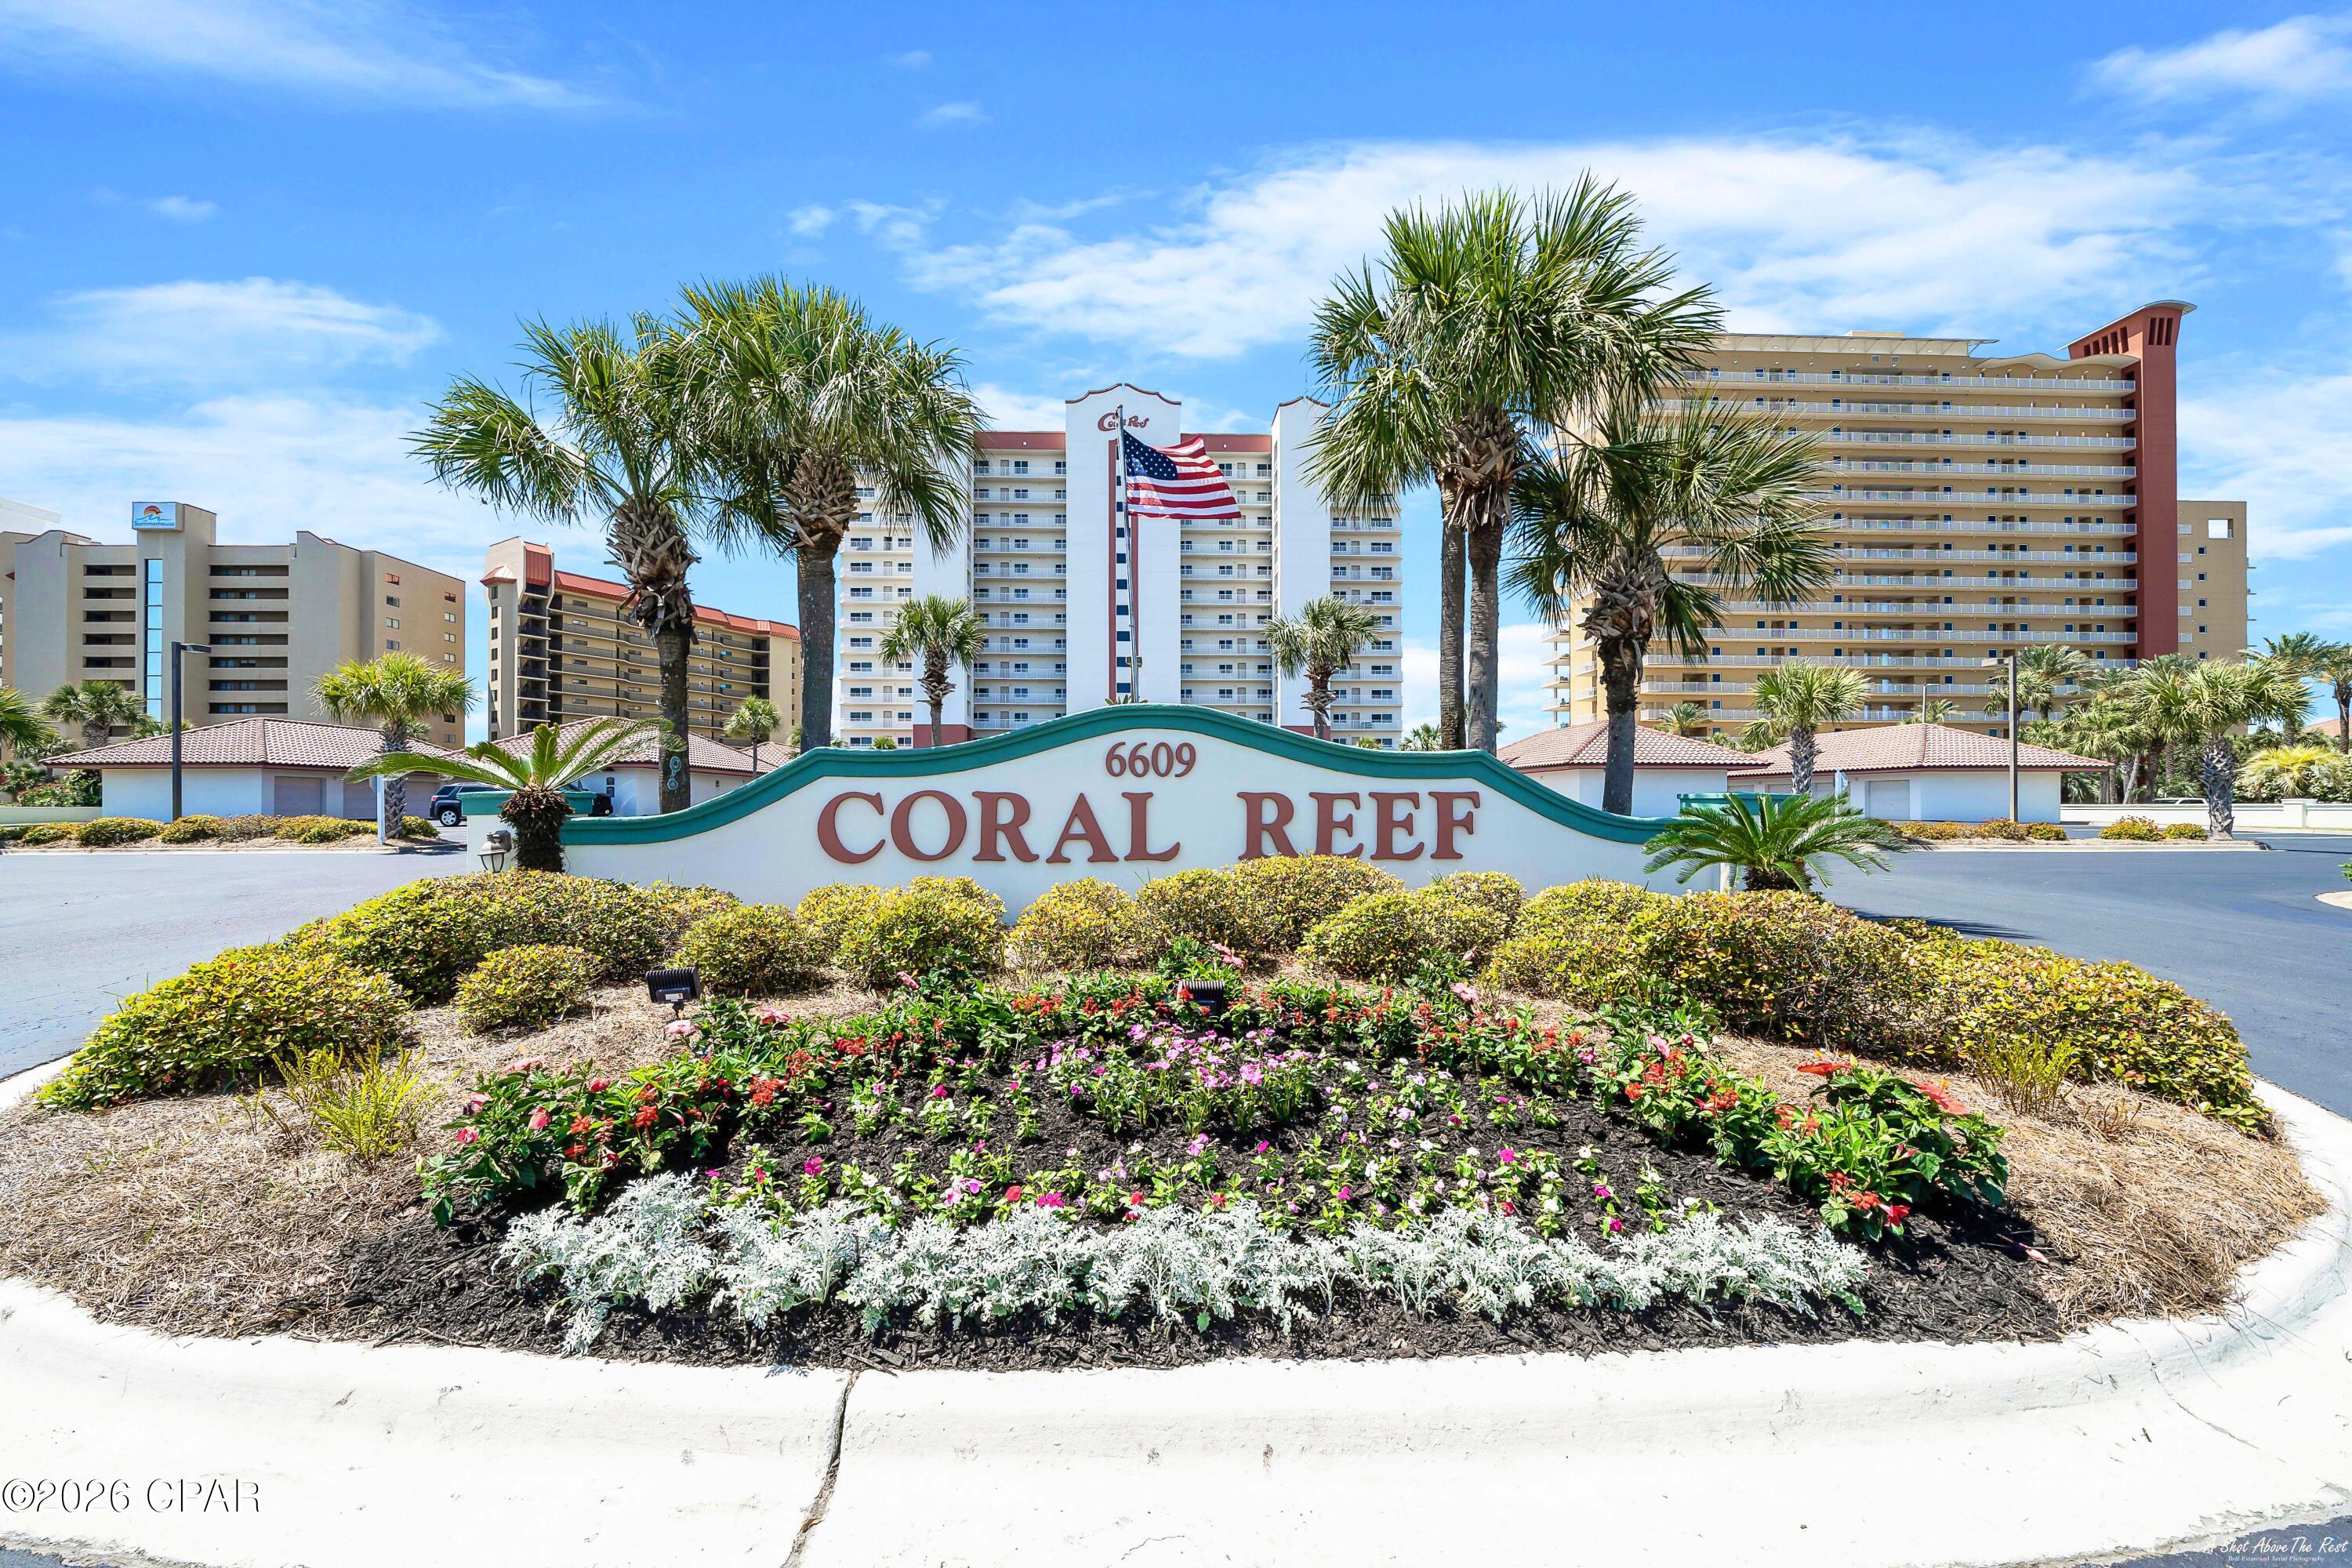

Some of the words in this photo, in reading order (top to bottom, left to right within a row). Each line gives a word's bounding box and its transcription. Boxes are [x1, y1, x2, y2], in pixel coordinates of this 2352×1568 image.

[1127, 415, 1150, 429] Reef
[1105, 742, 1196, 778] 6609
[817, 789, 1181, 865] CORAL
[1236, 791, 1481, 862] REEF
